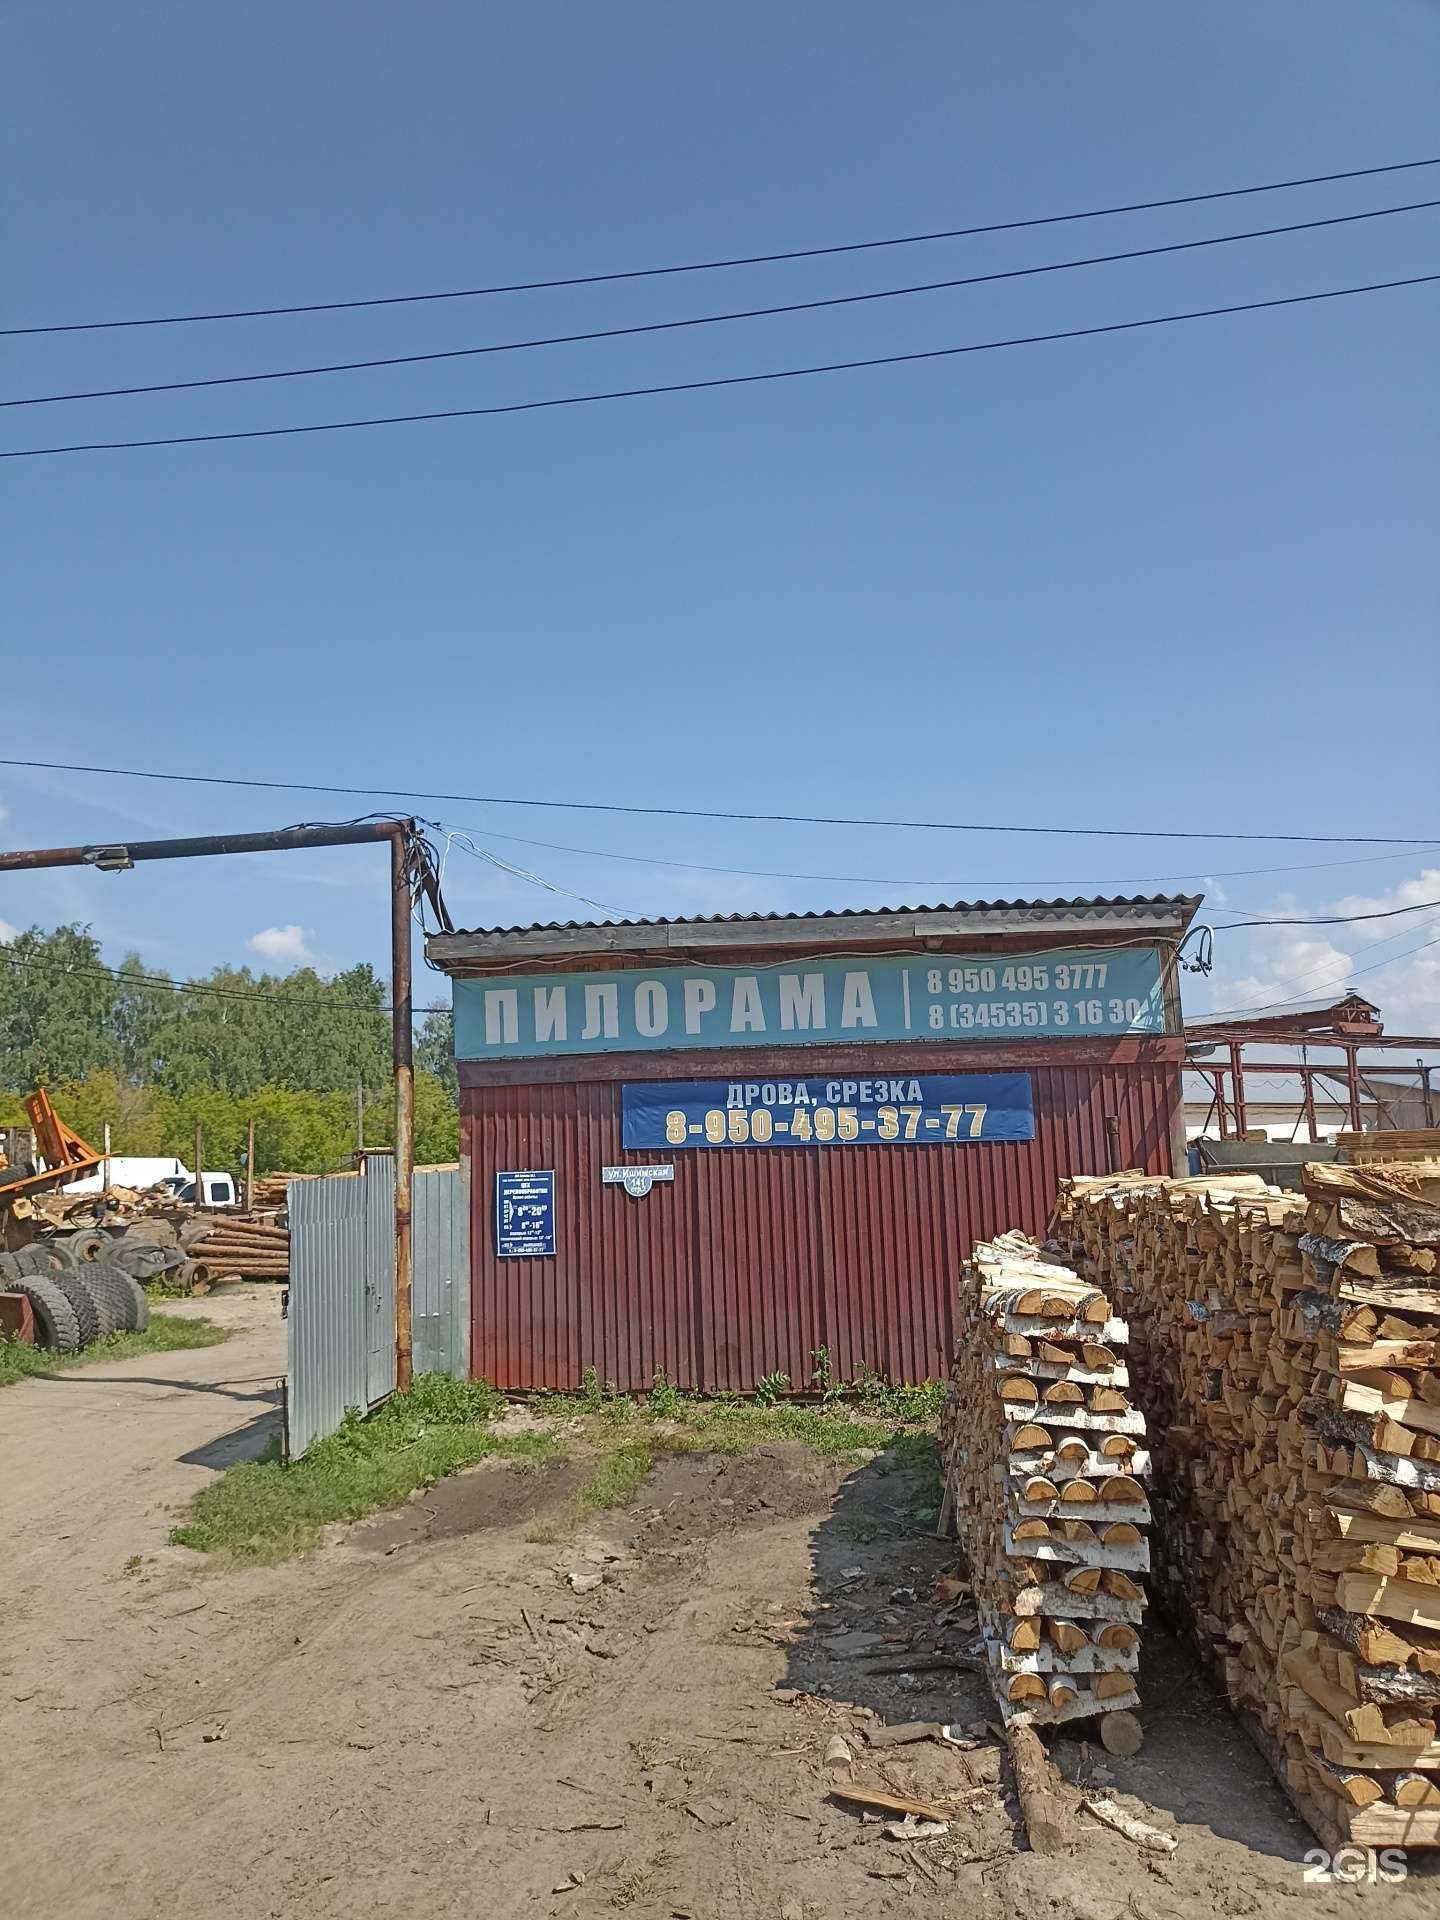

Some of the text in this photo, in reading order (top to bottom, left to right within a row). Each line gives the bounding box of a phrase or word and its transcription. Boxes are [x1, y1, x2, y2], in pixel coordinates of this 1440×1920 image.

[927, 963, 1108, 994] 8 950 495 3777
[484, 971, 878, 1045] ПИЛОРАМА
[929, 998, 1141, 1030] 8 (34535) 3 16 30
[726, 1080, 924, 1109] ДРОВА, СРЕЗКА
[666, 1103, 988, 1144] 8-950-495-37-77
